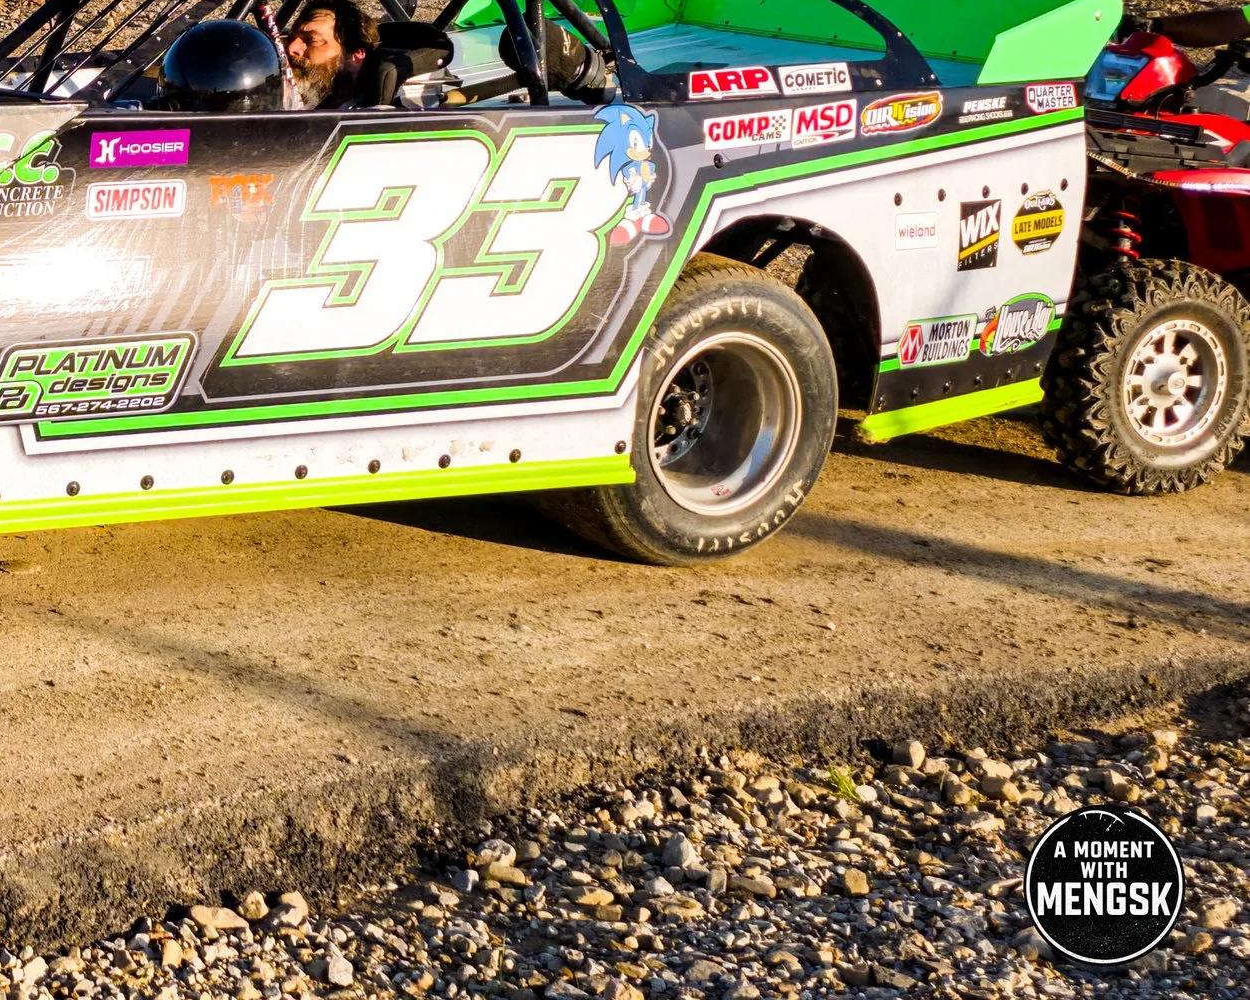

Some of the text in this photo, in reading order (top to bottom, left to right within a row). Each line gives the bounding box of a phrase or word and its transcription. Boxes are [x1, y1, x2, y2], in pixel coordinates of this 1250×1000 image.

[691, 69, 769, 94] ARP
[785, 66, 847, 88] COMETIC
[963, 97, 1007, 113] PENSKE
[1028, 85, 1072, 104] QUARTER
[1037, 96, 1074, 112] MASTER
[709, 115, 771, 142] COMP
[796, 103, 853, 134] MSD
[751, 129, 782, 142] CAMS
[119, 142, 184, 154] HOOSIER
[94, 186, 177, 213] SIMPSON
[898, 223, 936, 239] wieland
[960, 201, 1000, 248] WIX
[1014, 215, 1063, 234] LATE MODELS
[220, 127, 634, 367] 33
[958, 241, 999, 269] FILTERS
[928, 320, 971, 342] MORTON
[9, 345, 180, 377] PLATINUM
[922, 339, 970, 362] BUILDINGS
[48, 372, 169, 394] designs
[35, 397, 165, 415] 567-274-2202
